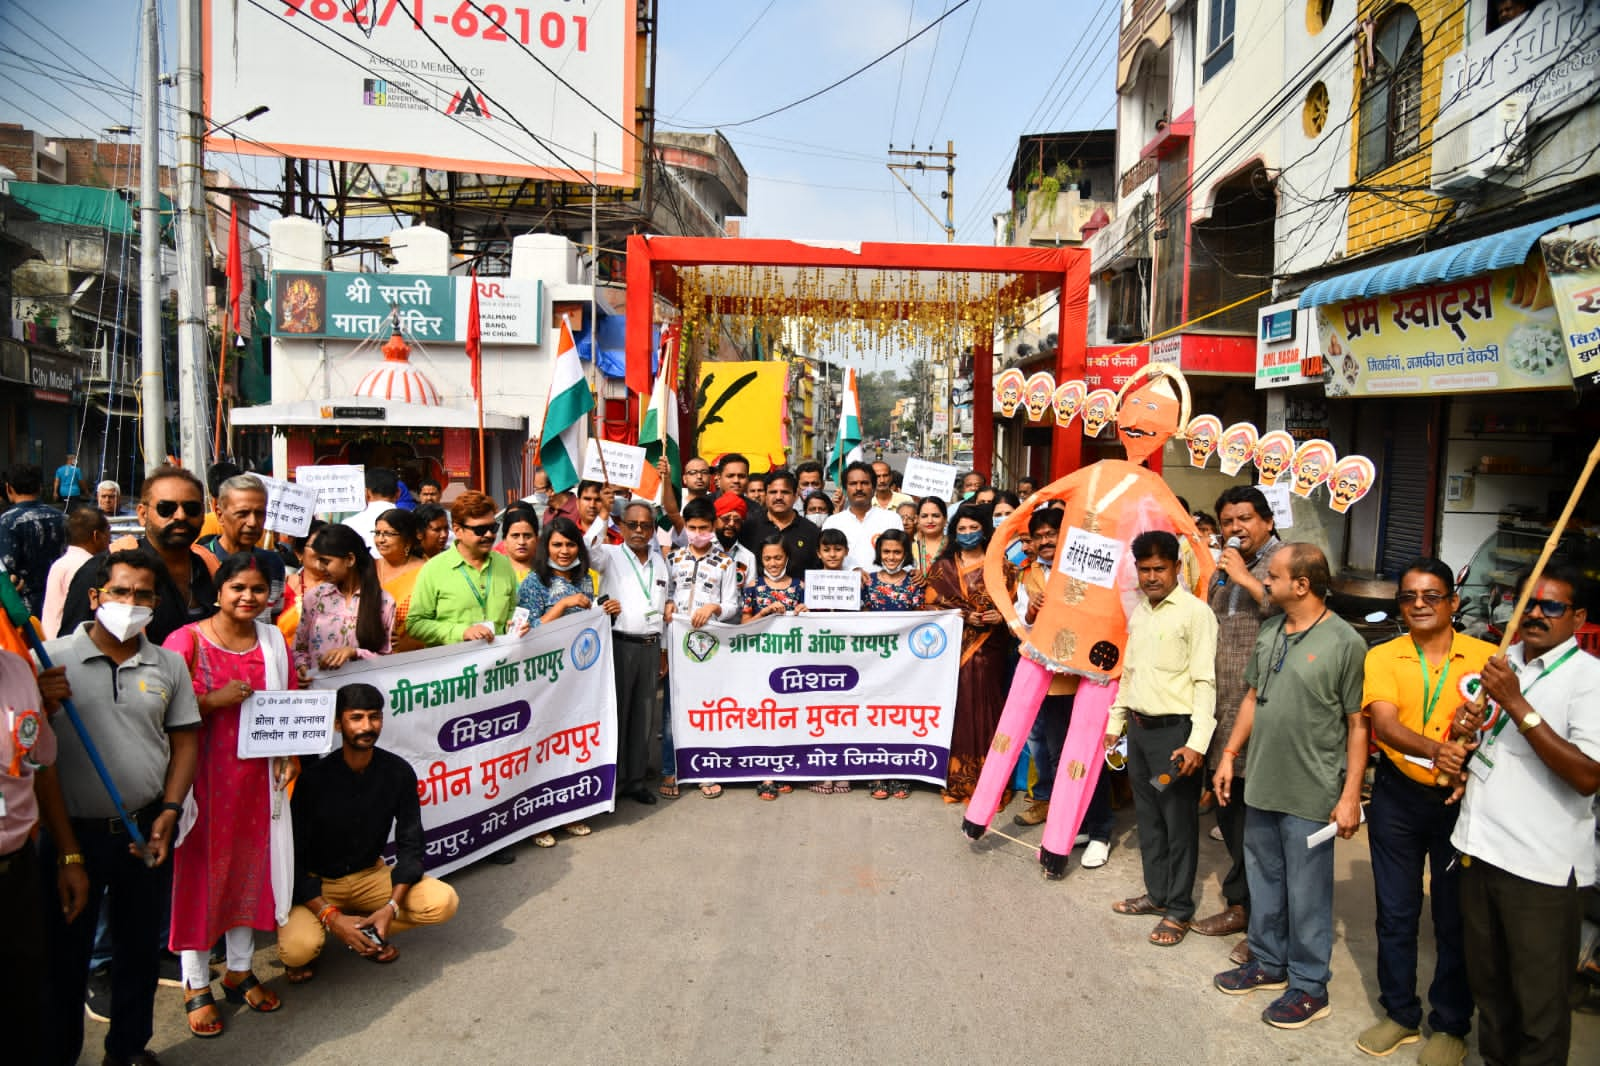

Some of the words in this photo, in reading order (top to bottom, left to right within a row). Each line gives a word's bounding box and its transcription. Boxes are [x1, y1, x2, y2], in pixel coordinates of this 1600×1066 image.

[369, 55, 377, 65] A
[380, 56, 418, 69] PROUD
[421, 61, 468, 75] MEMBER
[471, 67, 486, 77] OF
[346, 277, 371, 304] श्री
[377, 279, 432, 305] सत्ती
[332, 314, 381, 334] माता
[1407, 352, 1444, 370] नमकीन
[1447, 347, 1464, 366] एवं
[1467, 344, 1499, 364] बेकरी
[33, 367, 48, 390] City
[49, 370, 73, 391] Mobile
[728, 627, 804, 655] ग्रीनआर्मी
[807, 629, 847, 653] ऑफ
[850, 632, 901, 659] रायपुर
[389, 664, 479, 716] ग्रीनआर्मी
[483, 657, 520, 695] ऑफ
[523, 648, 566, 682] रायपुर
[781, 668, 847, 692] मिशन
[256, 714, 275, 725] झोला
[279, 716, 289, 725] ला
[450, 709, 522, 749] मिशन
[688, 696, 799, 732] पॉलिथीन
[806, 705, 859, 737] मुक्त
[866, 705, 942, 737] रायपुर
[251, 729, 285, 741] पॉलिथीन
[288, 730, 298, 740] ला
[417, 761, 473, 807] थीन
[480, 747, 531, 799] मुक्त
[536, 721, 601, 763] रायपुर
[690, 752, 731, 772] (मोर
[738, 754, 801, 774] रायपुर,
[807, 748, 837, 766] मोर
[844, 748, 938, 771] जिम्मेदारी)
[425, 828, 476, 857] यपुर,
[481, 809, 508, 834] मोर
[512, 776, 602, 821] जिम्मेदारी)
